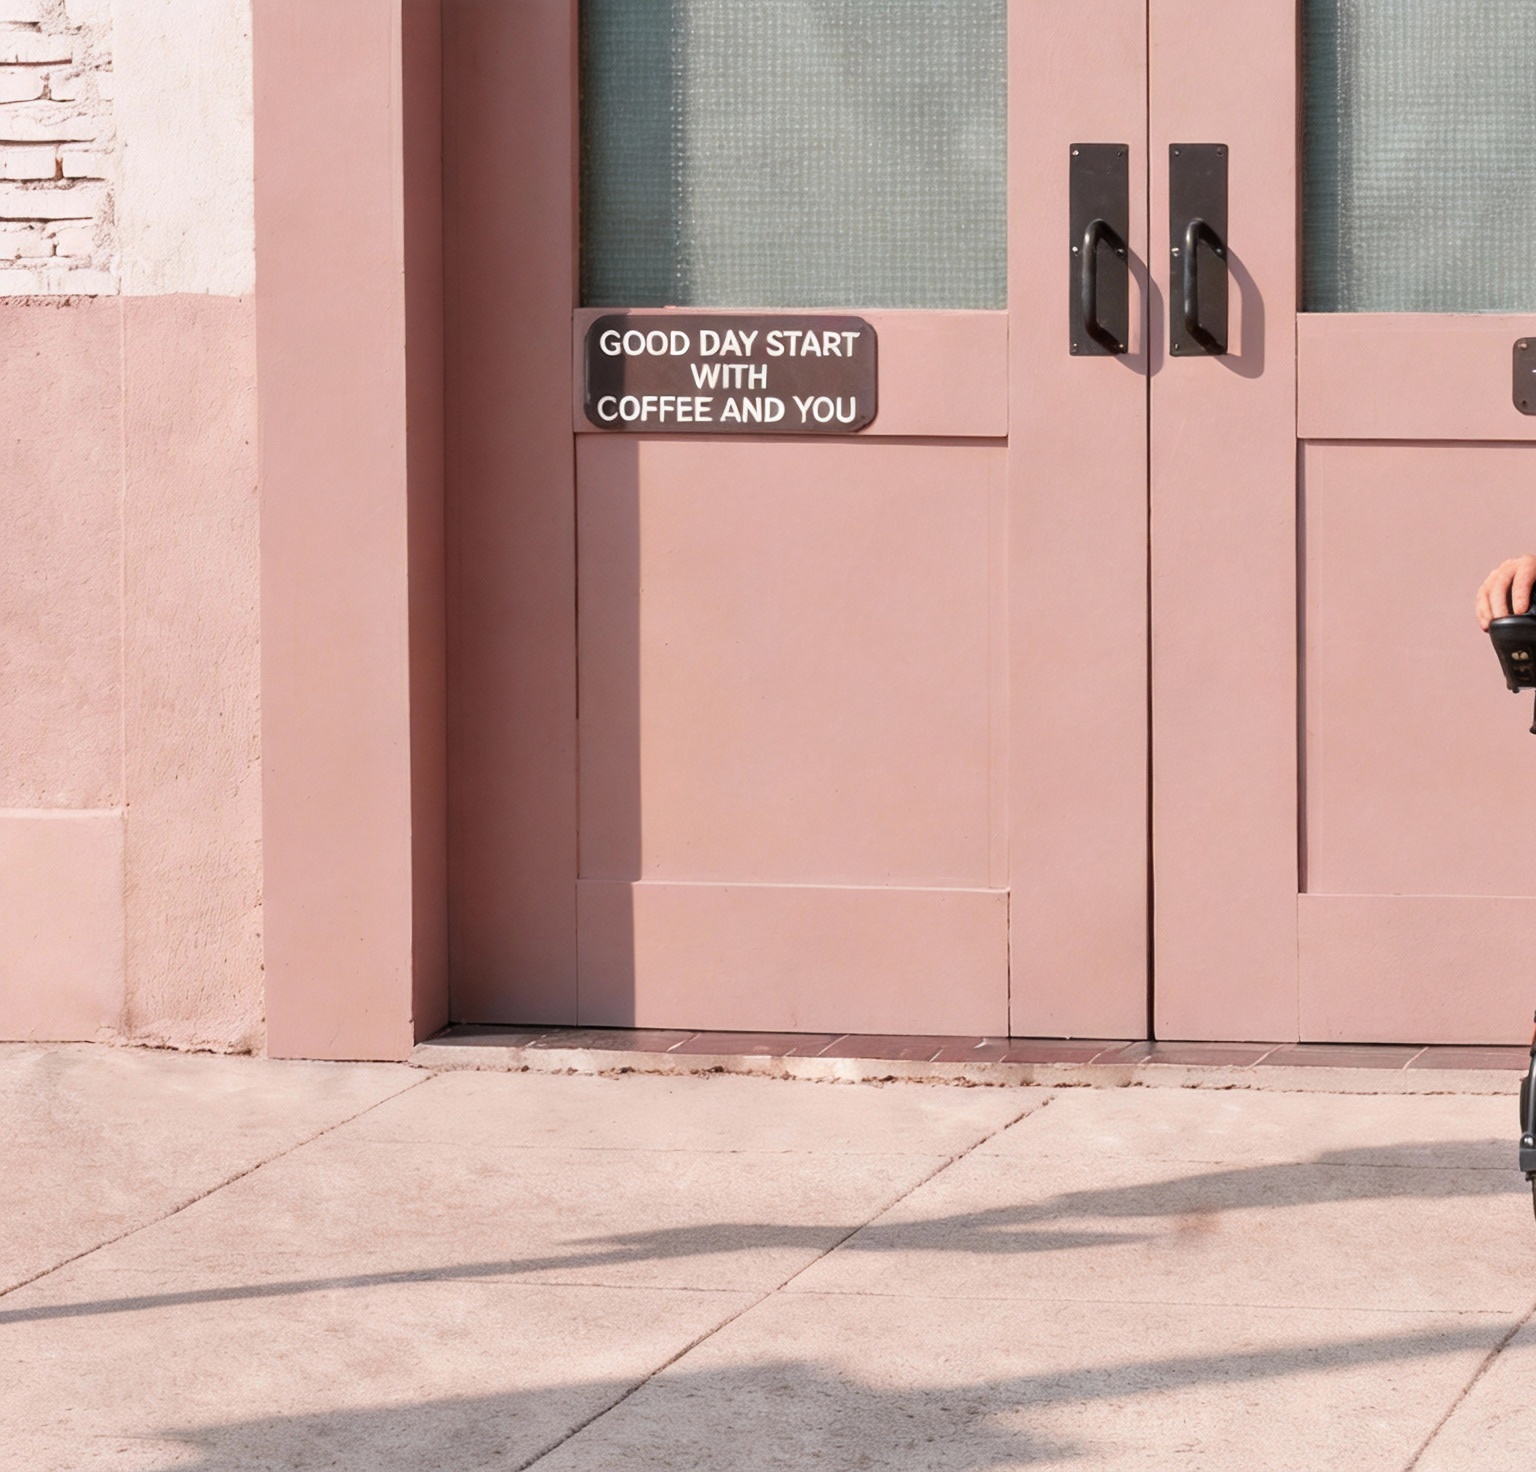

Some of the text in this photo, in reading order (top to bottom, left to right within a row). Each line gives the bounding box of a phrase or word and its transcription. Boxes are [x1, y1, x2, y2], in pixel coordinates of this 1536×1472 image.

[600, 330, 860, 357] GOOD DAY START
[691, 363, 768, 390] WITH
[597, 396, 857, 424] COFFEE AND YOU
